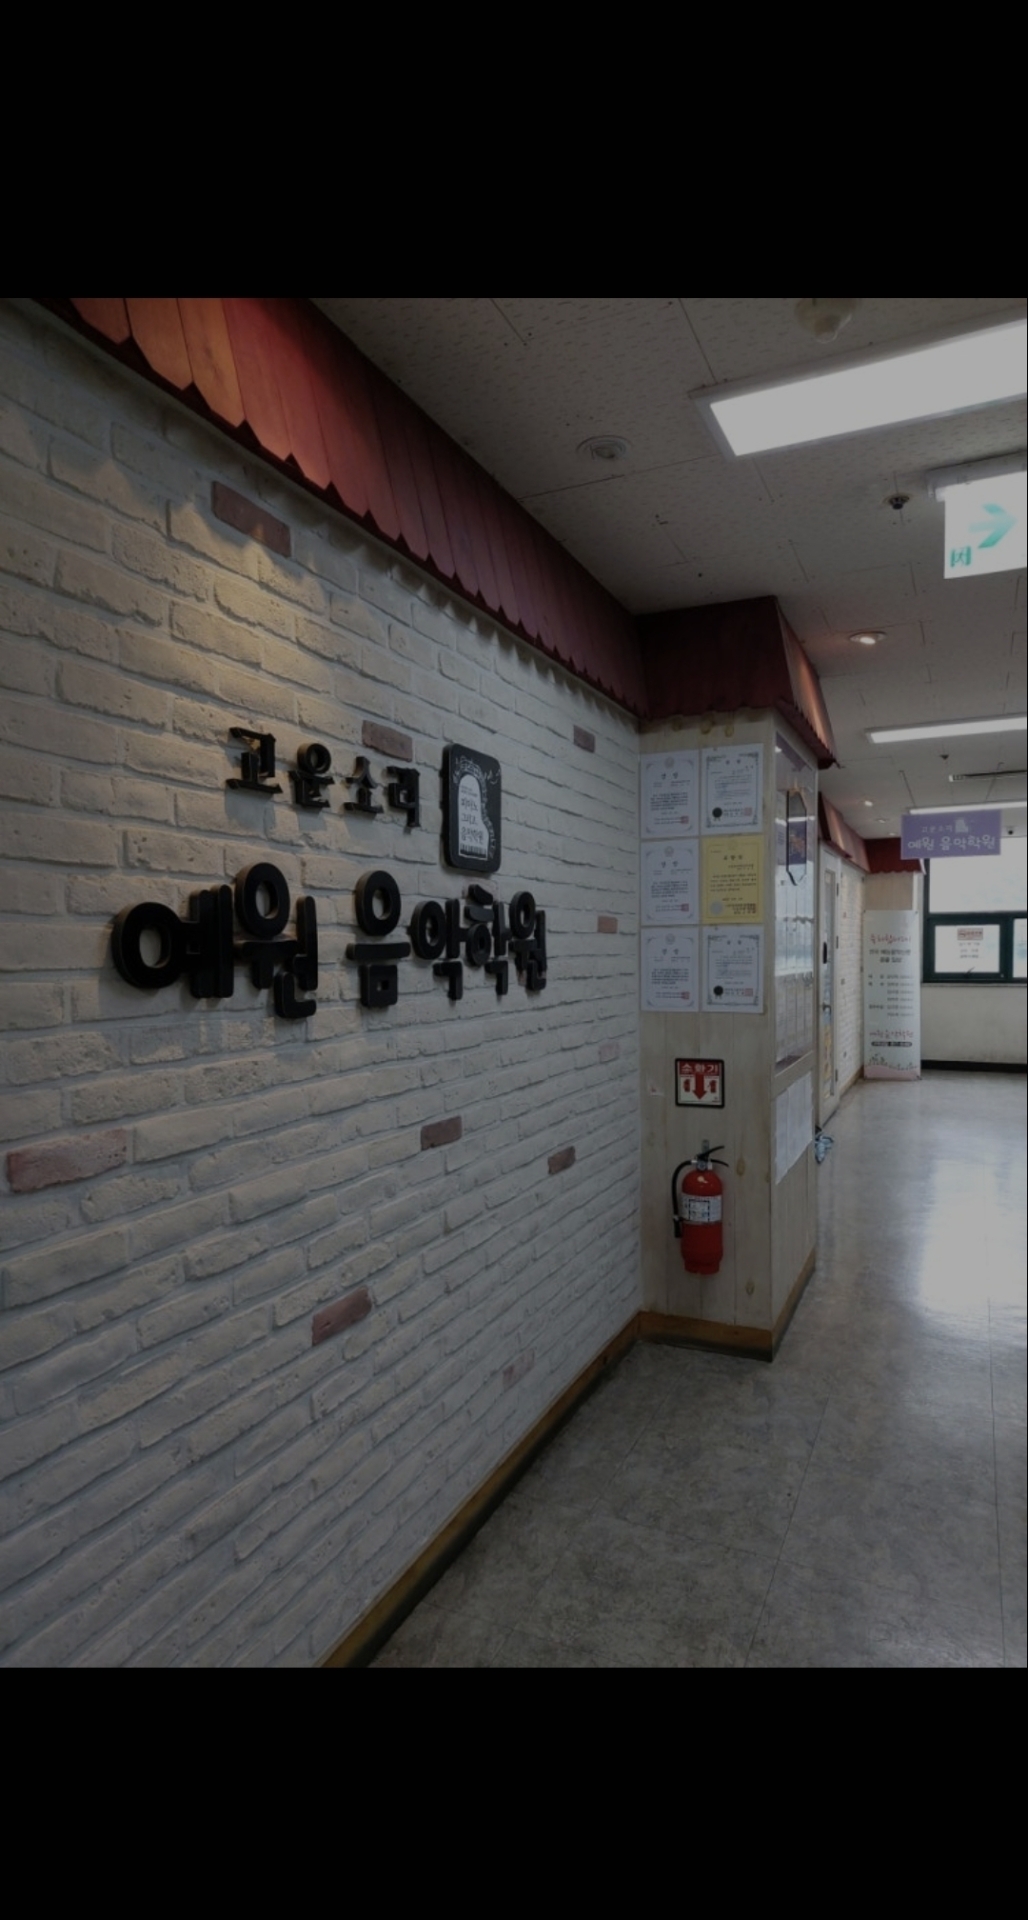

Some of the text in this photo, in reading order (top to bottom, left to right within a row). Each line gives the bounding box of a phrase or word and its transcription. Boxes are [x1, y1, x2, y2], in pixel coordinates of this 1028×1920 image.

[226, 727, 420, 829] 고운소리
[908, 833, 996, 851] 예원 음악학원
[112, 862, 547, 1019] 예원 음악학원
[681, 1063, 719, 1073] 소화기
